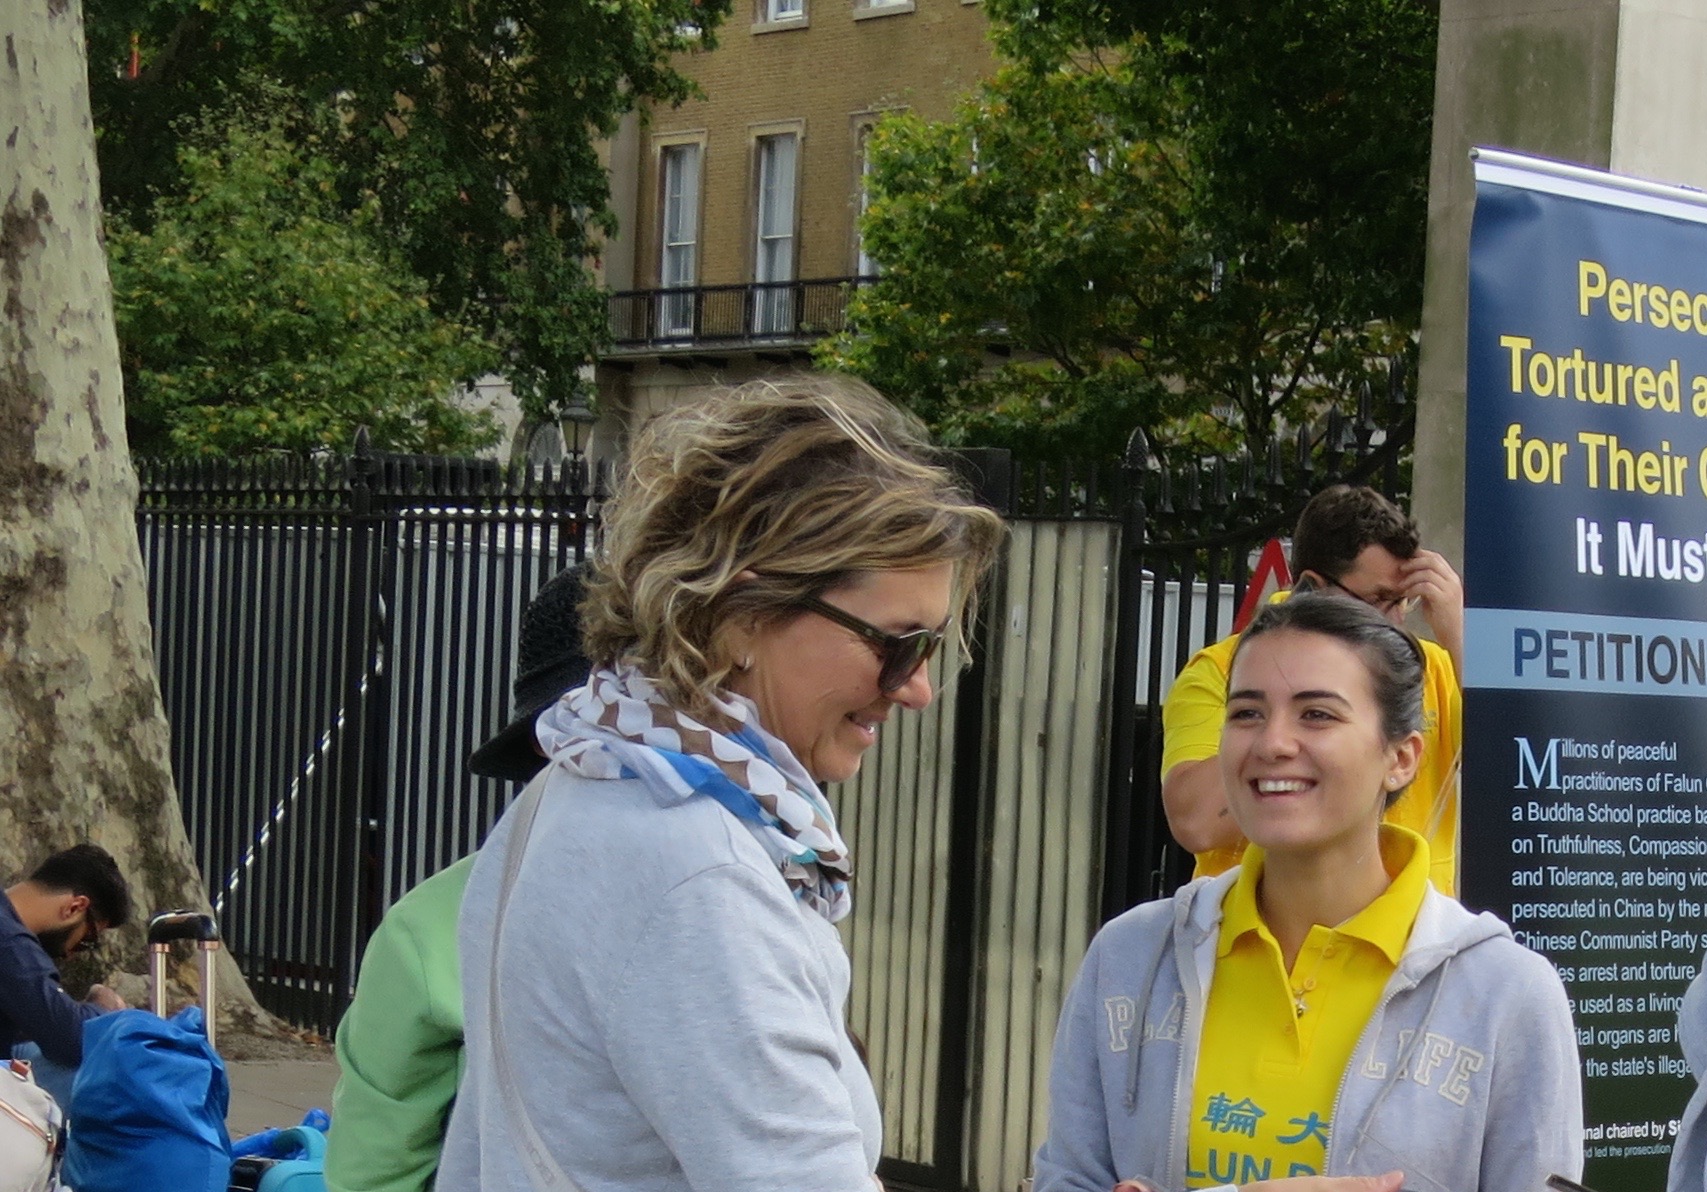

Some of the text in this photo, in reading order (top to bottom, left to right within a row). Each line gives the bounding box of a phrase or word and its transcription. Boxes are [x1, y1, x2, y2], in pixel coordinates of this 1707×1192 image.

[1500, 335, 1681, 414] Tortured
[1503, 424, 1568, 484] for
[1578, 432, 1688, 498] Their
[1576, 517, 1602, 575] It
[1514, 628, 1706, 687] PETITION
[1601, 740, 1615, 759] of
[1618, 741, 1677, 764] peaceful
[1562, 771, 1643, 794] practitioners
[1646, 772, 1661, 792] of
[1664, 773, 1702, 793] Falun
[1512, 805, 1522, 821] a
[1528, 802, 1584, 822] Buddha
[1588, 803, 1633, 823] School
[1637, 805, 1692, 827] practice
[1512, 838, 1533, 854] on
[1537, 834, 1626, 857] Truthfulness,
[1512, 867, 1543, 886] and
[1547, 867, 1618, 888] Tolerance,
[1622, 872, 1643, 886] are
[1648, 868, 1686, 891] being
[1512, 899, 1595, 923] persecuted
[1600, 899, 1610, 919] in
[1614, 899, 1654, 919] China
[1658, 899, 1675, 922] by
[1679, 899, 1699, 918] the
[1513, 930, 1576, 951] Chinese
[1580, 930, 1658, 950] Communist
[1661, 930, 1697, 953] Party
[1579, 964, 1618, 982] arrest
[1622, 962, 1647, 981] and
[1651, 962, 1696, 981] torture
[1580, 994, 1613, 1014] used
[1617, 999, 1632, 1013] as
[1637, 999, 1646, 1013] a
[1598, 1028, 1644, 1050] organs
[1648, 1029, 1670, 1044] are
[1586, 1058, 1608, 1078] the
[1611, 1056, 1655, 1077] state's
[1606, 1121, 1649, 1140] chaired
[1651, 1121, 1665, 1140] by
[1624, 1143, 1671, 1159] prosecution
